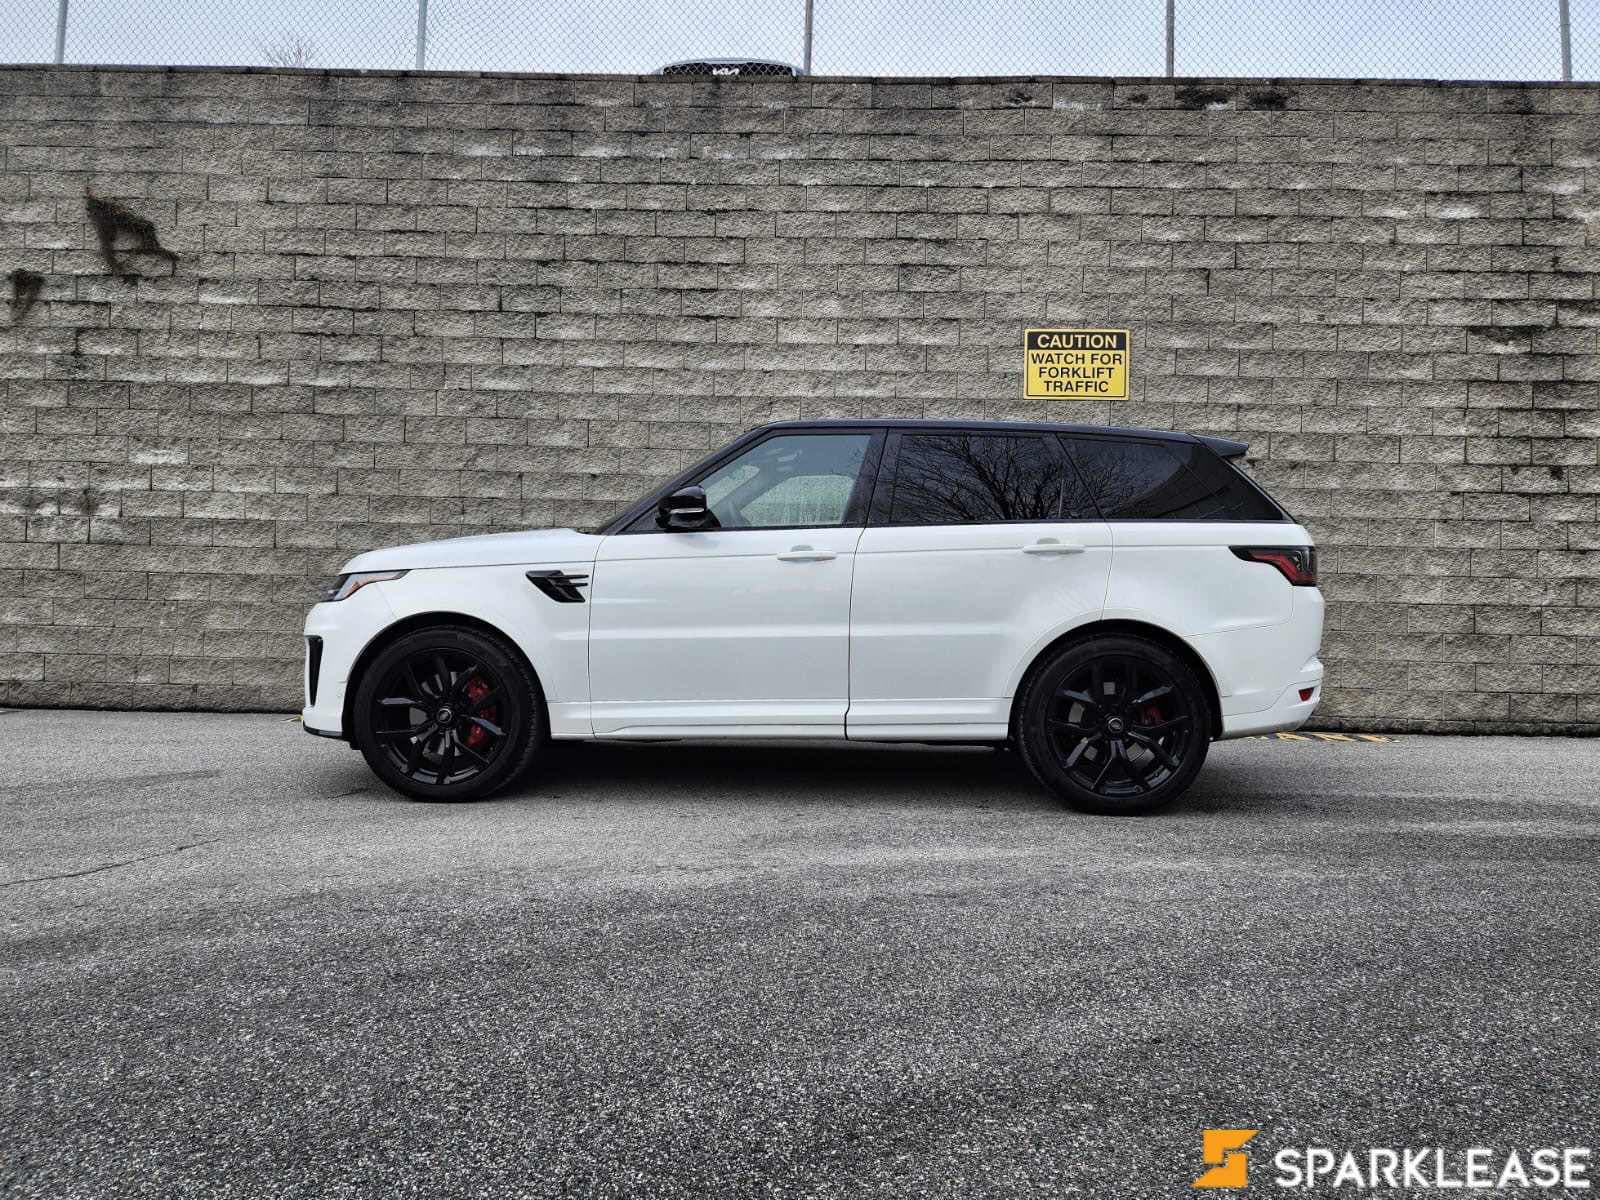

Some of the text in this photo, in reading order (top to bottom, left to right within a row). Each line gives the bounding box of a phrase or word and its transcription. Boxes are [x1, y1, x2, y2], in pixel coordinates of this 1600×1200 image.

[1037, 334, 1117, 349] CAUTION
[1031, 353, 1122, 365] WATCH FOR
[1038, 366, 1115, 379] FORKLIFT
[1043, 380, 1109, 393] TRAFFIC
